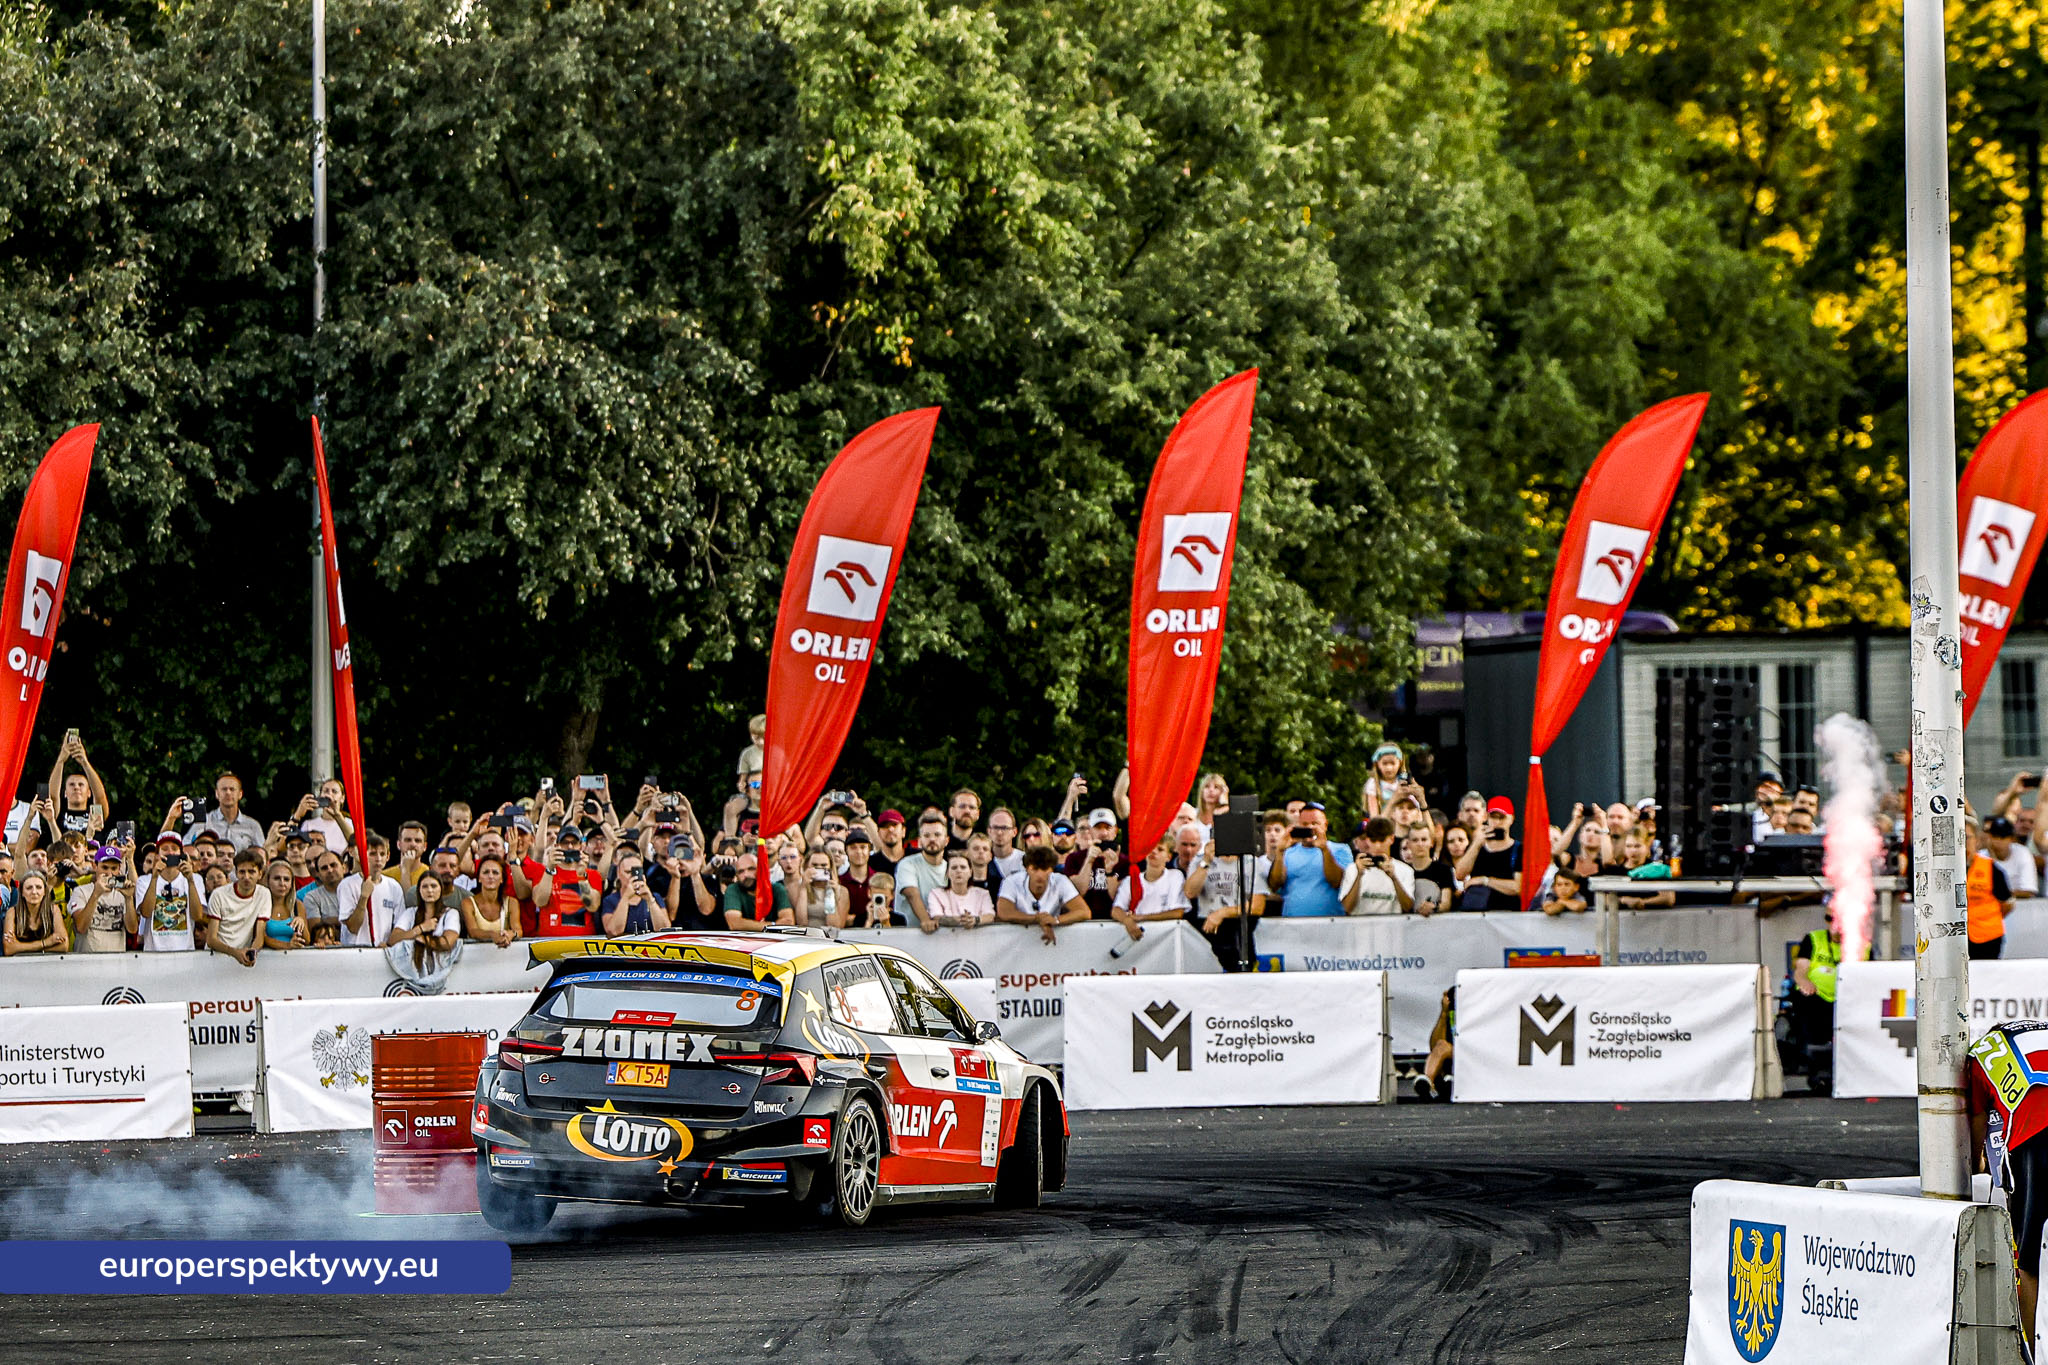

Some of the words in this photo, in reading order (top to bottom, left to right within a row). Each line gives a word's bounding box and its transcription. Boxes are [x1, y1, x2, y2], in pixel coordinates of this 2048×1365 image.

[815, 662, 846, 683] OIL
[736, 989, 759, 1010] 8
[834, 985, 852, 1023] 8
[1000, 999, 1064, 1019] STADIO
[1206, 1015, 1293, 1031] Górnośląsko
[1589, 1011, 1672, 1027] Górnośląsko
[560, 1026, 718, 1063] ZŁOMEX
[1206, 1033, 1315, 1049] -Zagłębiowska
[1589, 1028, 1692, 1045] -Zagłębiowska
[0, 1044, 105, 1062] inisterstwo
[1206, 1050, 1284, 1065] Metropolia
[1589, 1046, 1662, 1062] Metropolia
[52, 1067, 57, 1084] i
[63, 1065, 145, 1087] Turystyki
[2000, 1062, 2024, 1104] POL
[414, 1116, 456, 1127] ORLEN
[414, 1129, 431, 1137] OIL
[593, 1115, 671, 1153] LOTTO
[740, 1172, 783, 1181] MICHELIN
[1803, 1234, 1916, 1278] Województwo
[1801, 1278, 1859, 1325] Śląskie
